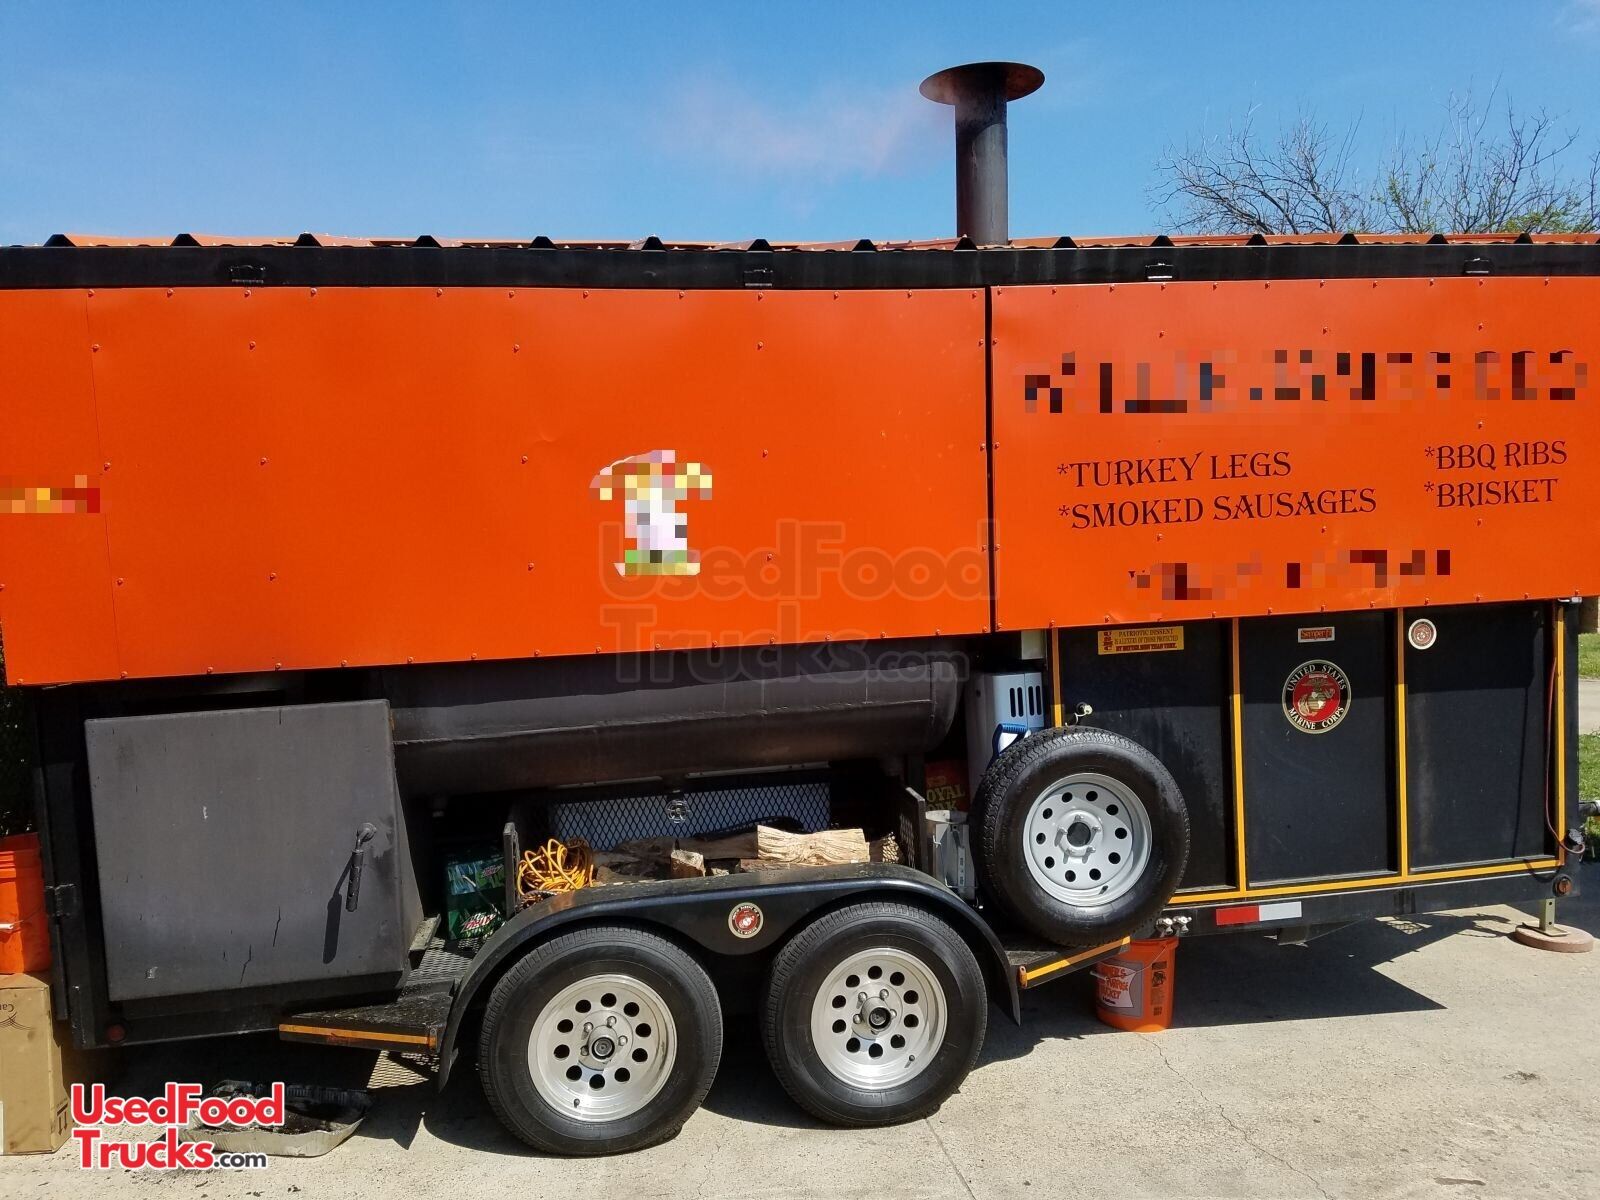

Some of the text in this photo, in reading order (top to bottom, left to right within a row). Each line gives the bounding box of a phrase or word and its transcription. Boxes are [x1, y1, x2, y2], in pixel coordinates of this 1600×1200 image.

[1210, 451, 1292, 480] LEGS
[1503, 440, 1568, 468] RIBS
[1213, 488, 1377, 521] SAUSAGES
[1287, 664, 1347, 691] UNITED STATES
[1288, 706, 1345, 730] MARINE CORPS
[926, 784, 966, 802] OYAL
